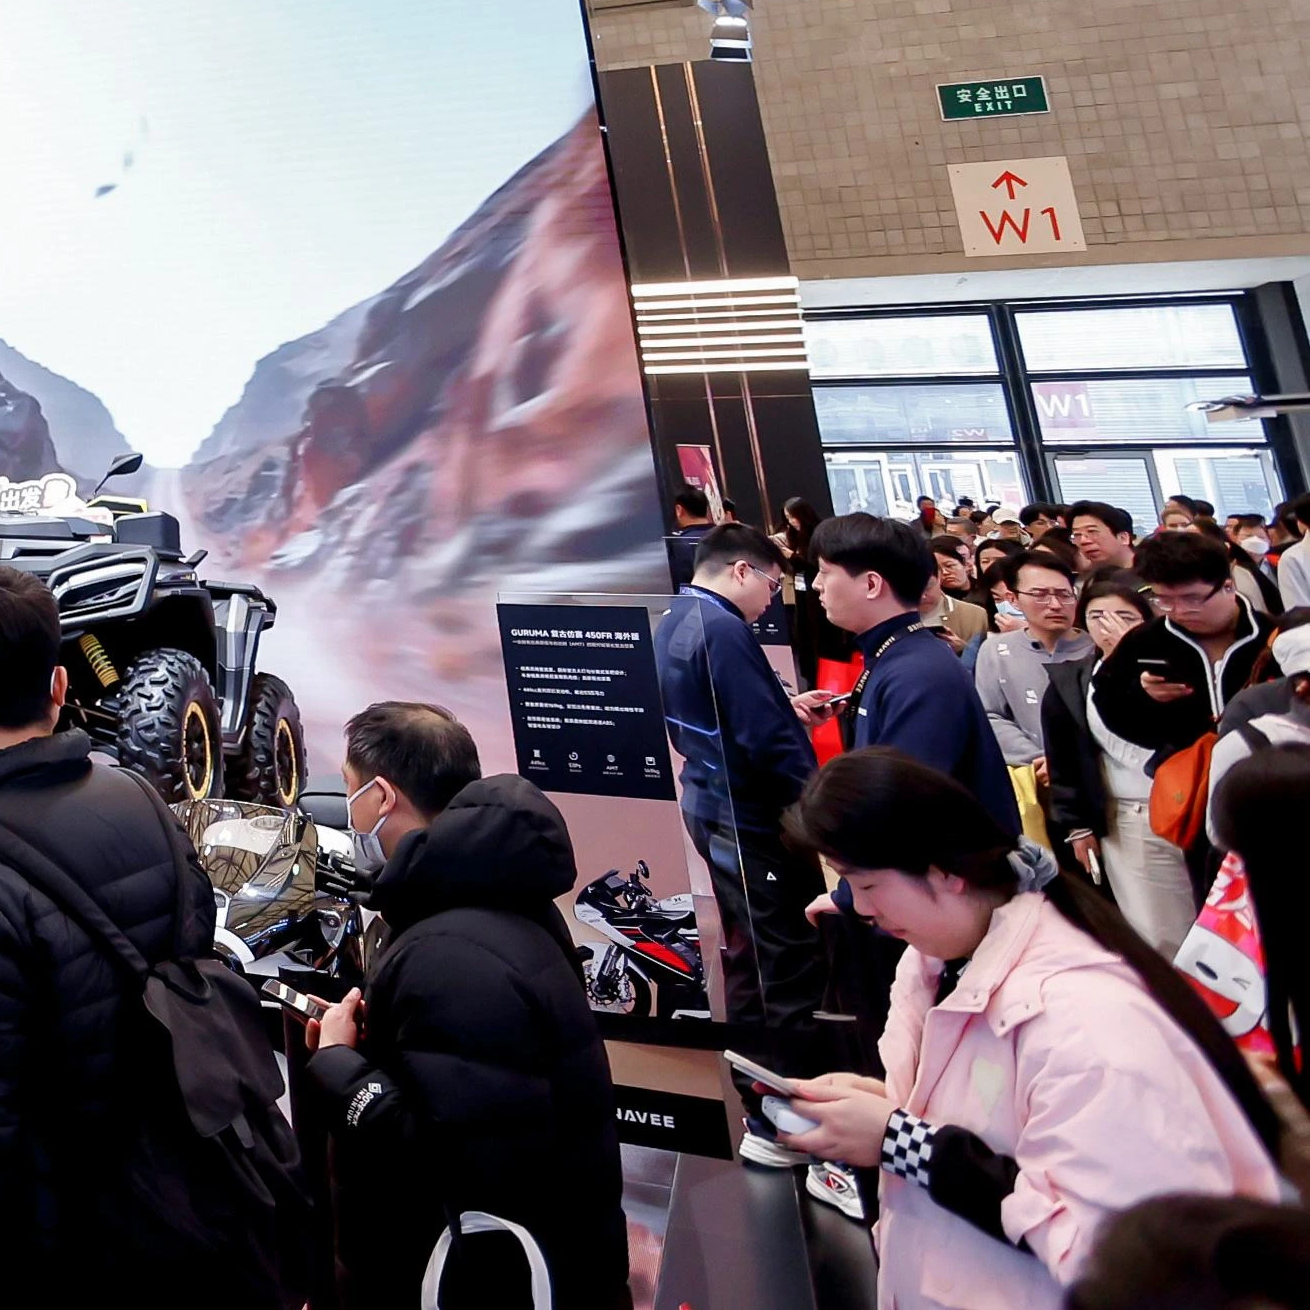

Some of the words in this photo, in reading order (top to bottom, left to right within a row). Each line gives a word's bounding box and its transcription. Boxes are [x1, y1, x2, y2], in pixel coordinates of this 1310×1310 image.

[956, 84, 1027, 103] 安全出口
[974, 101, 1012, 112] EXIT
[979, 207, 1060, 245] W1
[1036, 393, 1090, 418] W1
[0, 486, 42, 511] 出发
[511, 629, 549, 638] GURUMA
[585, 632, 613, 640] 450FR
